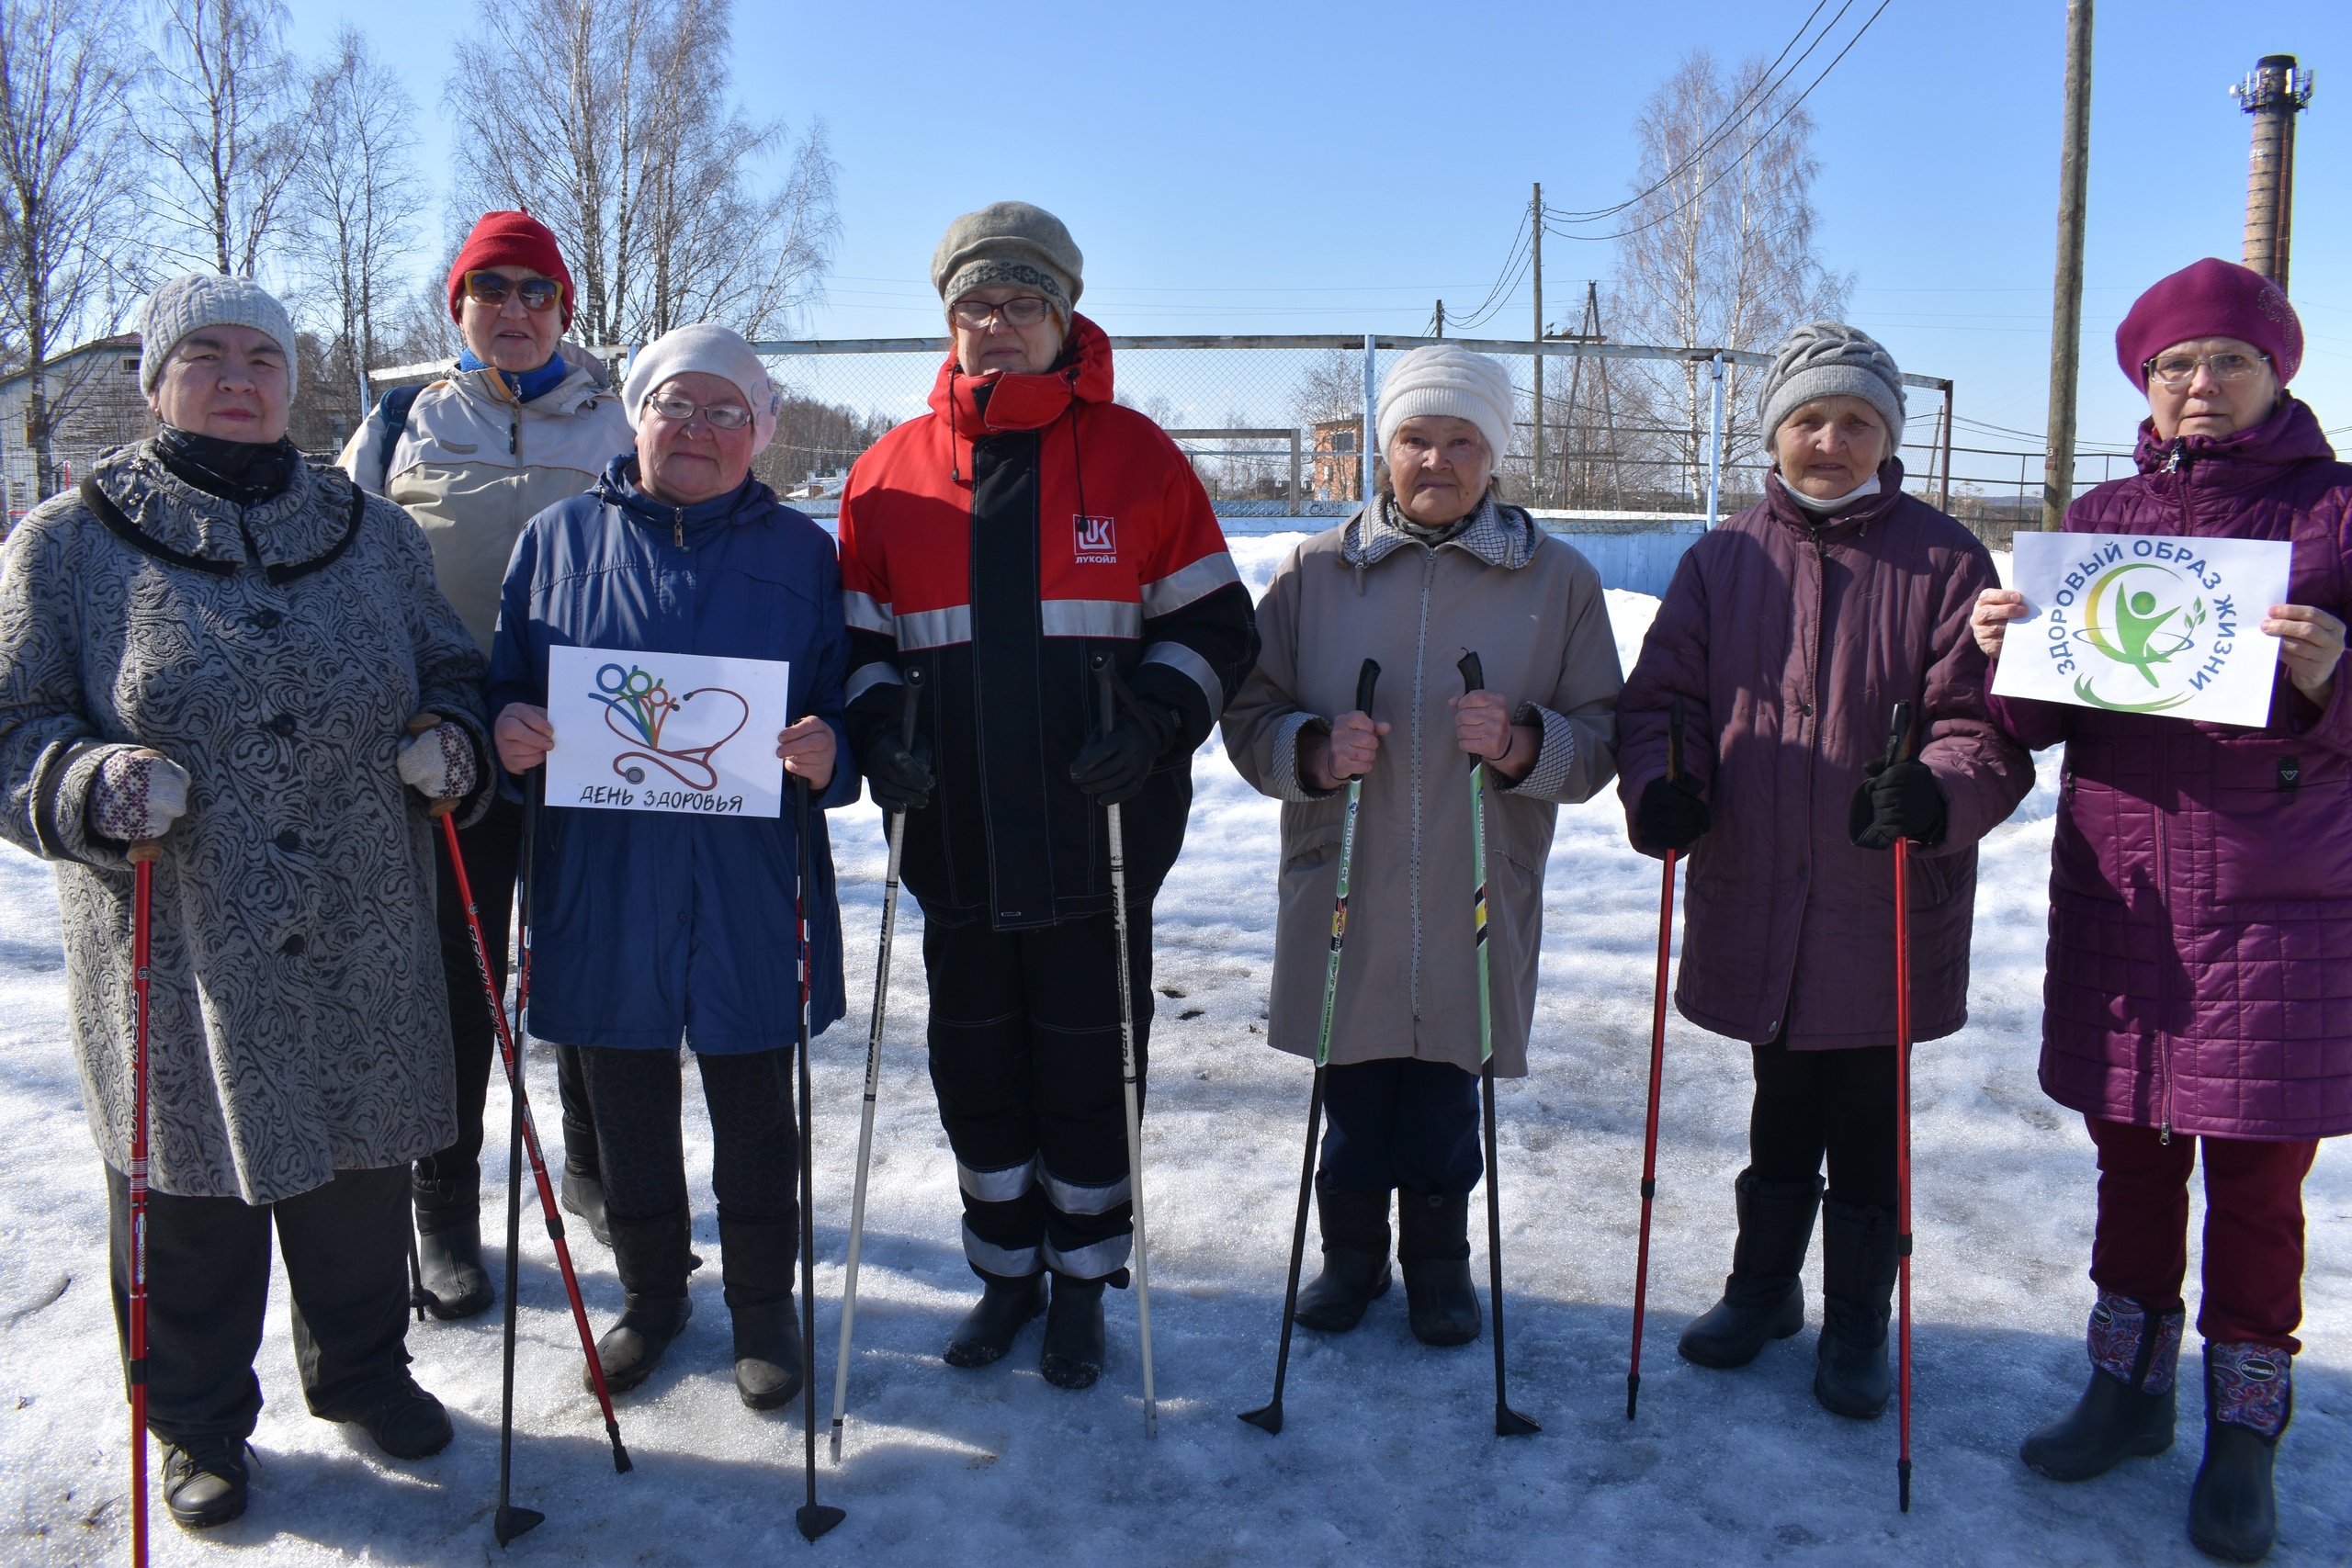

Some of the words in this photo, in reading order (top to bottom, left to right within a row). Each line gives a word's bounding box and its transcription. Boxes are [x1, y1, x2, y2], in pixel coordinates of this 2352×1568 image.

[1075, 554, 1116, 564] ЛУКОЙЛ
[2048, 540, 2124, 676] ЗДОРОВЫЙ
[2132, 539, 2222, 591] ОБРАЗ
[2188, 593, 2237, 692] ЖИЗНИ
[579, 785, 634, 807] ДЕНЬ
[643, 790, 743, 814] ЗДОРОВЬЯ
[1340, 818, 1353, 884] СПОРТ-СТ
